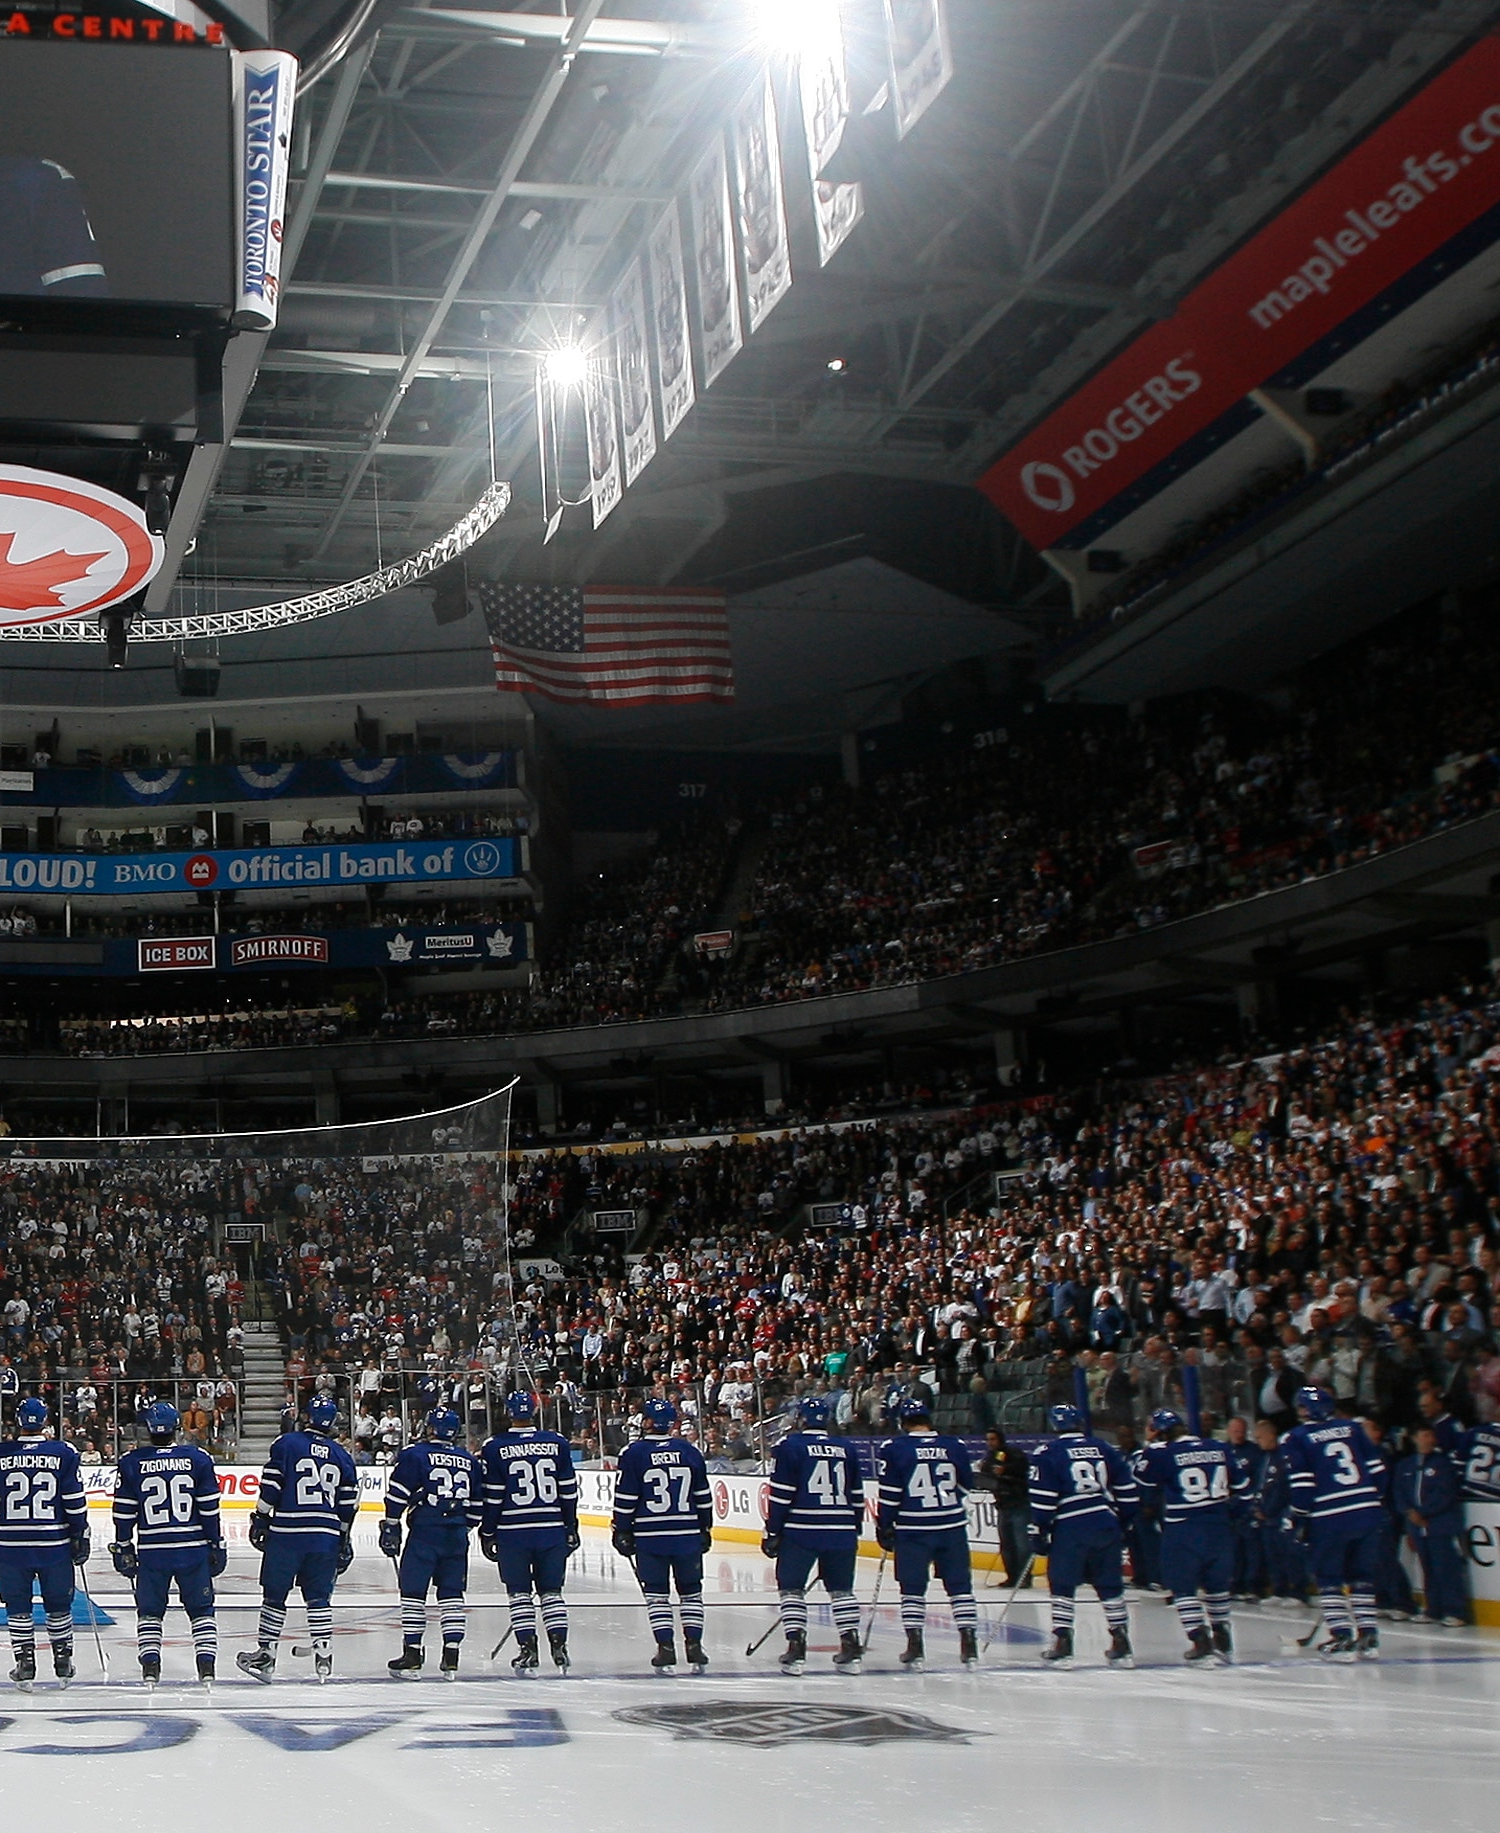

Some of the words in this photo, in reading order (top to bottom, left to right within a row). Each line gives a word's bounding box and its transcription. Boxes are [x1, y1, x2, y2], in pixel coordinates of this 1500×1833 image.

[53, 13, 225, 45] CENTRE
[247, 84, 274, 173] STAR
[245, 179, 269, 287] TORONTO
[1061, 357, 1202, 479] ROGERS
[678, 782, 707, 798] 317
[114, 863, 176, 884] BMO
[228, 851, 330, 884] Official
[339, 848, 416, 879] bank
[423, 846, 455, 874] of
[236, 940, 323, 960] SMIRNOFF
[427, 936, 472, 948] MeritusU
[145, 946, 172, 963] ICE
[175, 945, 209, 962] BOX
[597, 1214, 630, 1228] IBM
[230, 1227, 261, 1240] IBM
[310, 1443, 329, 1460] ORR
[499, 1443, 560, 1460] GUNNARSSON
[650, 1451, 683, 1466] BRENT
[806, 1444, 848, 1460] KULEMIN
[914, 1446, 949, 1461] BOZAK
[1065, 1446, 1105, 1460] KESSEL
[0, 1455, 61, 1471] BEAUCHEMIN
[138, 1457, 192, 1475] ZIGOMANIS
[427, 1453, 473, 1472] VERSTEEG
[1323, 1440, 1362, 1486] 3
[507, 1457, 558, 1506] 36
[642, 1465, 693, 1514] 37
[807, 1459, 848, 1506] 41
[907, 1462, 959, 1509] 42
[1069, 1459, 1115, 1503] 81
[4, 1471, 58, 1520] 22
[139, 1473, 196, 1525] 26
[731, 1489, 750, 1514] LG
